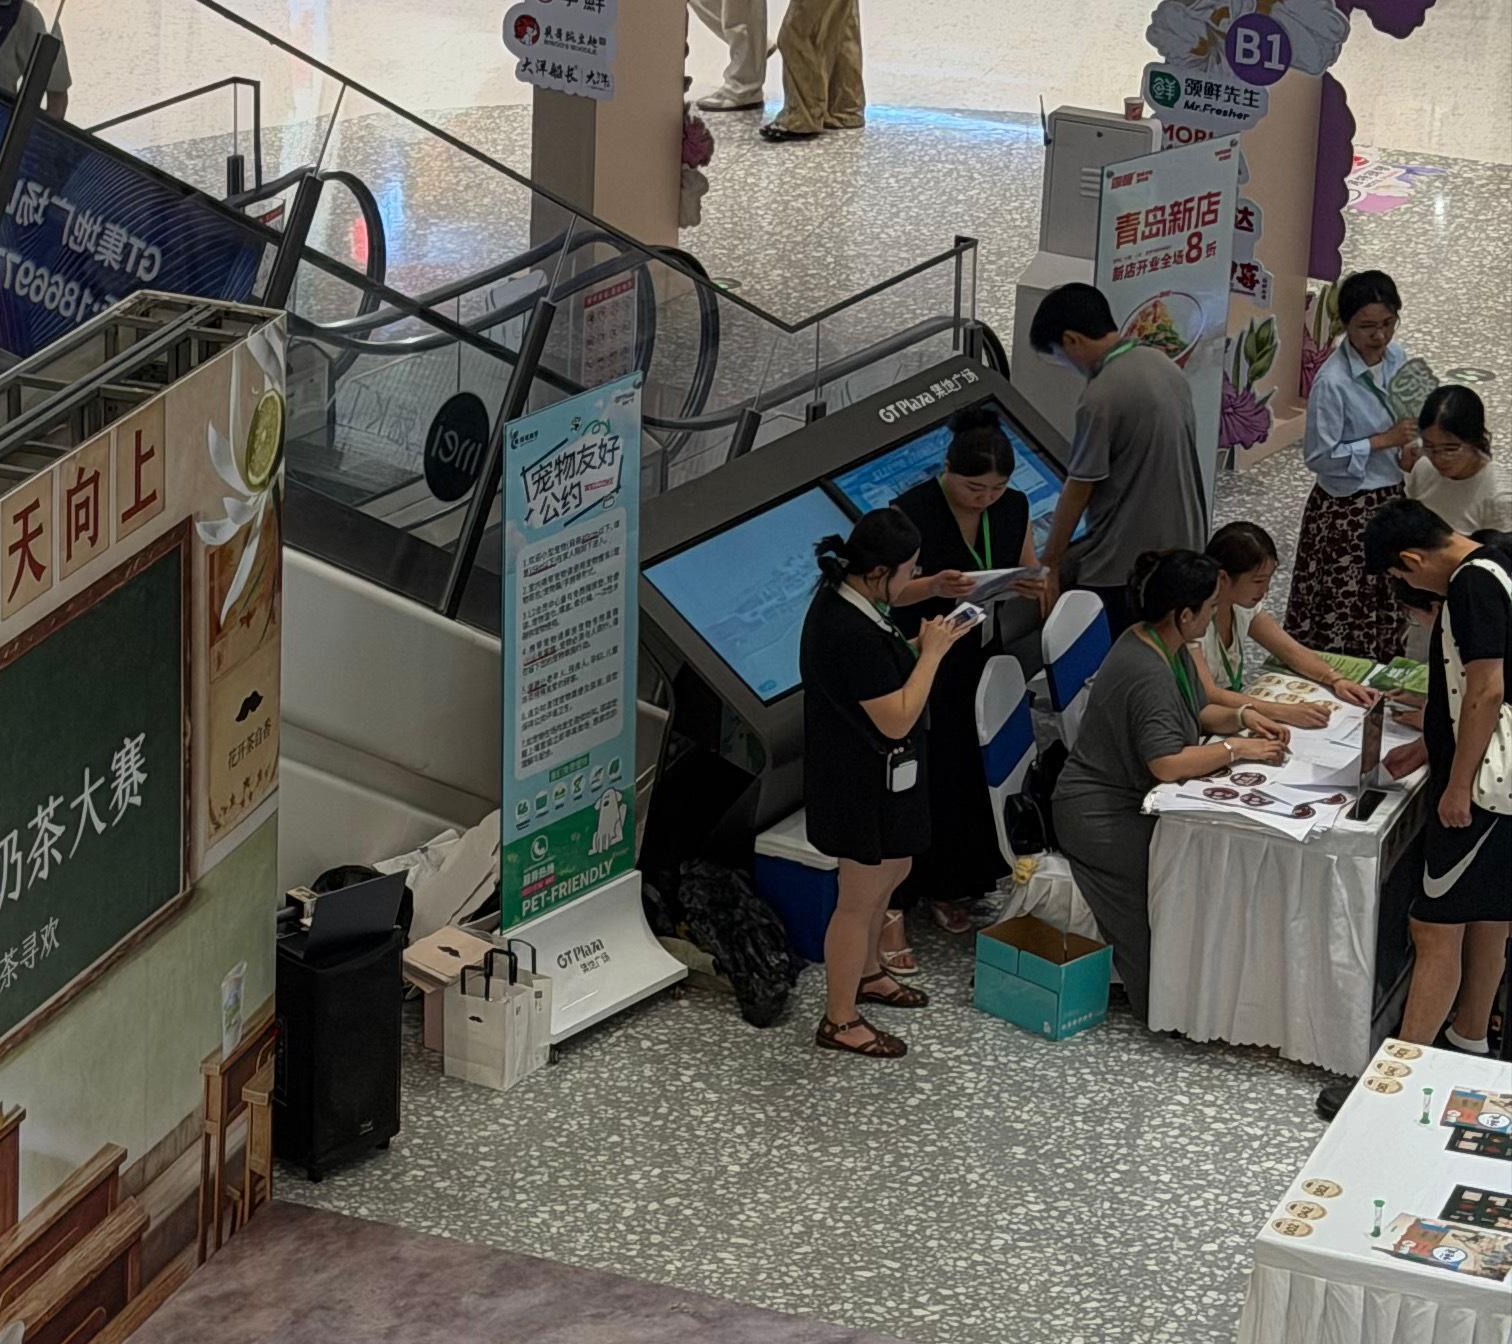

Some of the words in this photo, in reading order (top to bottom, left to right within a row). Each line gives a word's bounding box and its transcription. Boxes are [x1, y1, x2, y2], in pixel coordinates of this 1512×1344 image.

[1235, 27, 1286, 72] B1
[1115, 191, 1222, 250] 青岛新店
[531, 435, 620, 501] 宠物友好
[539, 480, 583, 525] 公约
[521, 857, 614, 918] PET-FRIENDLY
